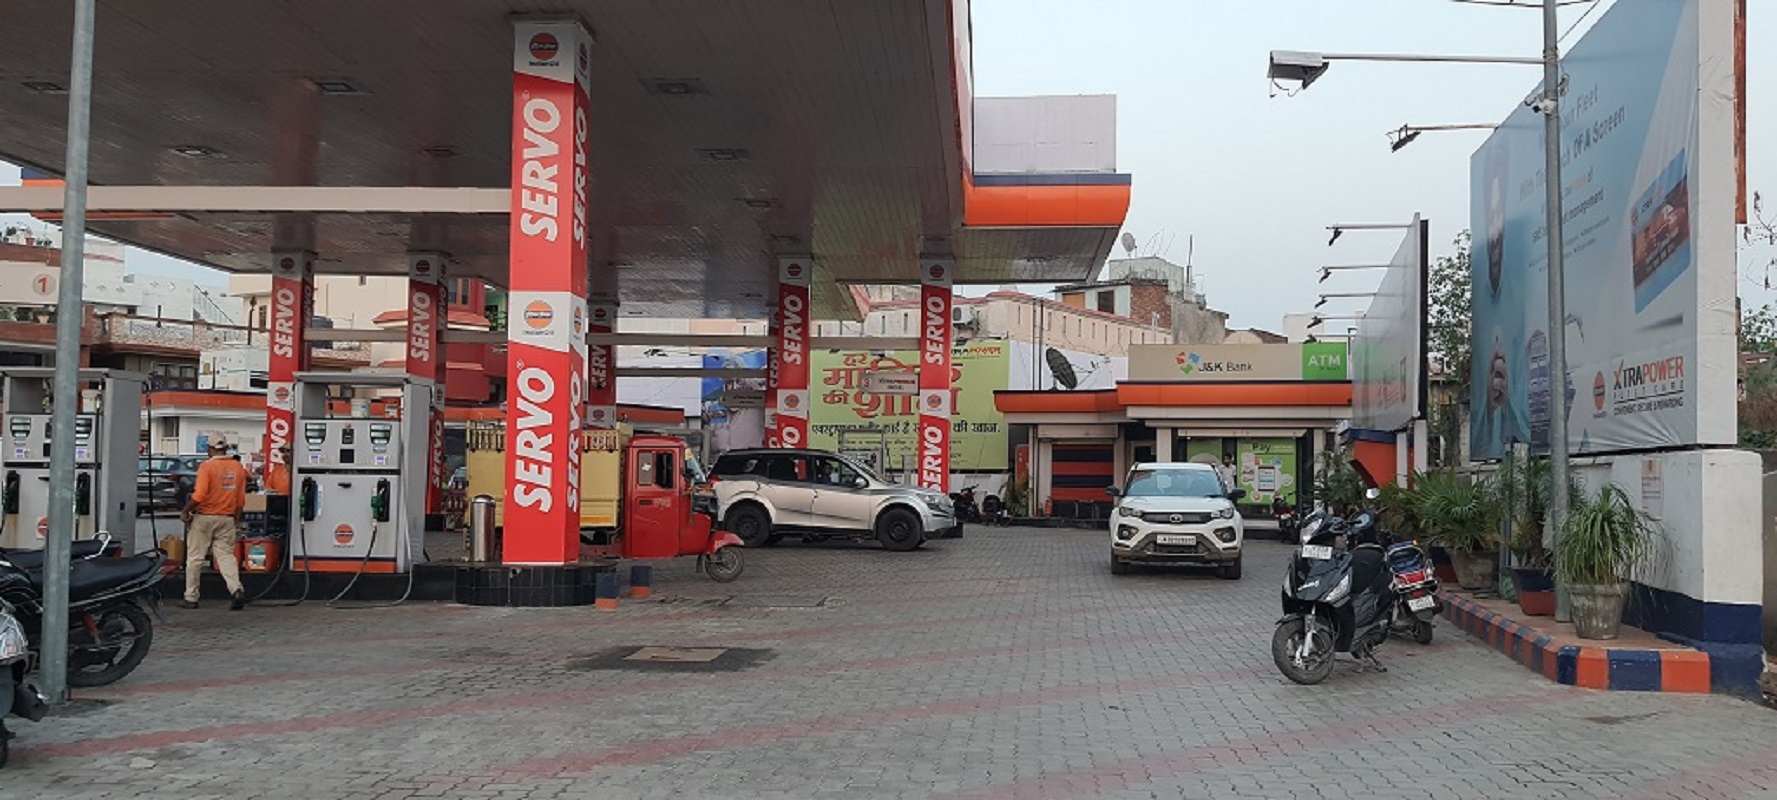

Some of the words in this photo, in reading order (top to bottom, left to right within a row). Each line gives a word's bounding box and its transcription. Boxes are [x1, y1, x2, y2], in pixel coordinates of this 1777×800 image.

[1592, 105, 1625, 145] Screen
[521, 98, 561, 242] SERVO
[574, 106, 587, 250] SERVO
[38, 277, 48, 293] 1
[274, 287, 296, 359] SERVO
[411, 291, 431, 362] SERVO
[783, 294, 803, 366] SERVO
[925, 296, 945, 366] SERVO
[1199, 362, 1223, 373] J&K
[1227, 362, 1254, 372] Bank
[1307, 354, 1341, 367] ATM
[1613, 356, 1685, 391] XTRAPOWER
[433, 419, 442, 489] SERVO
[514, 367, 555, 513] SERVO
[567, 371, 581, 513] SERVO
